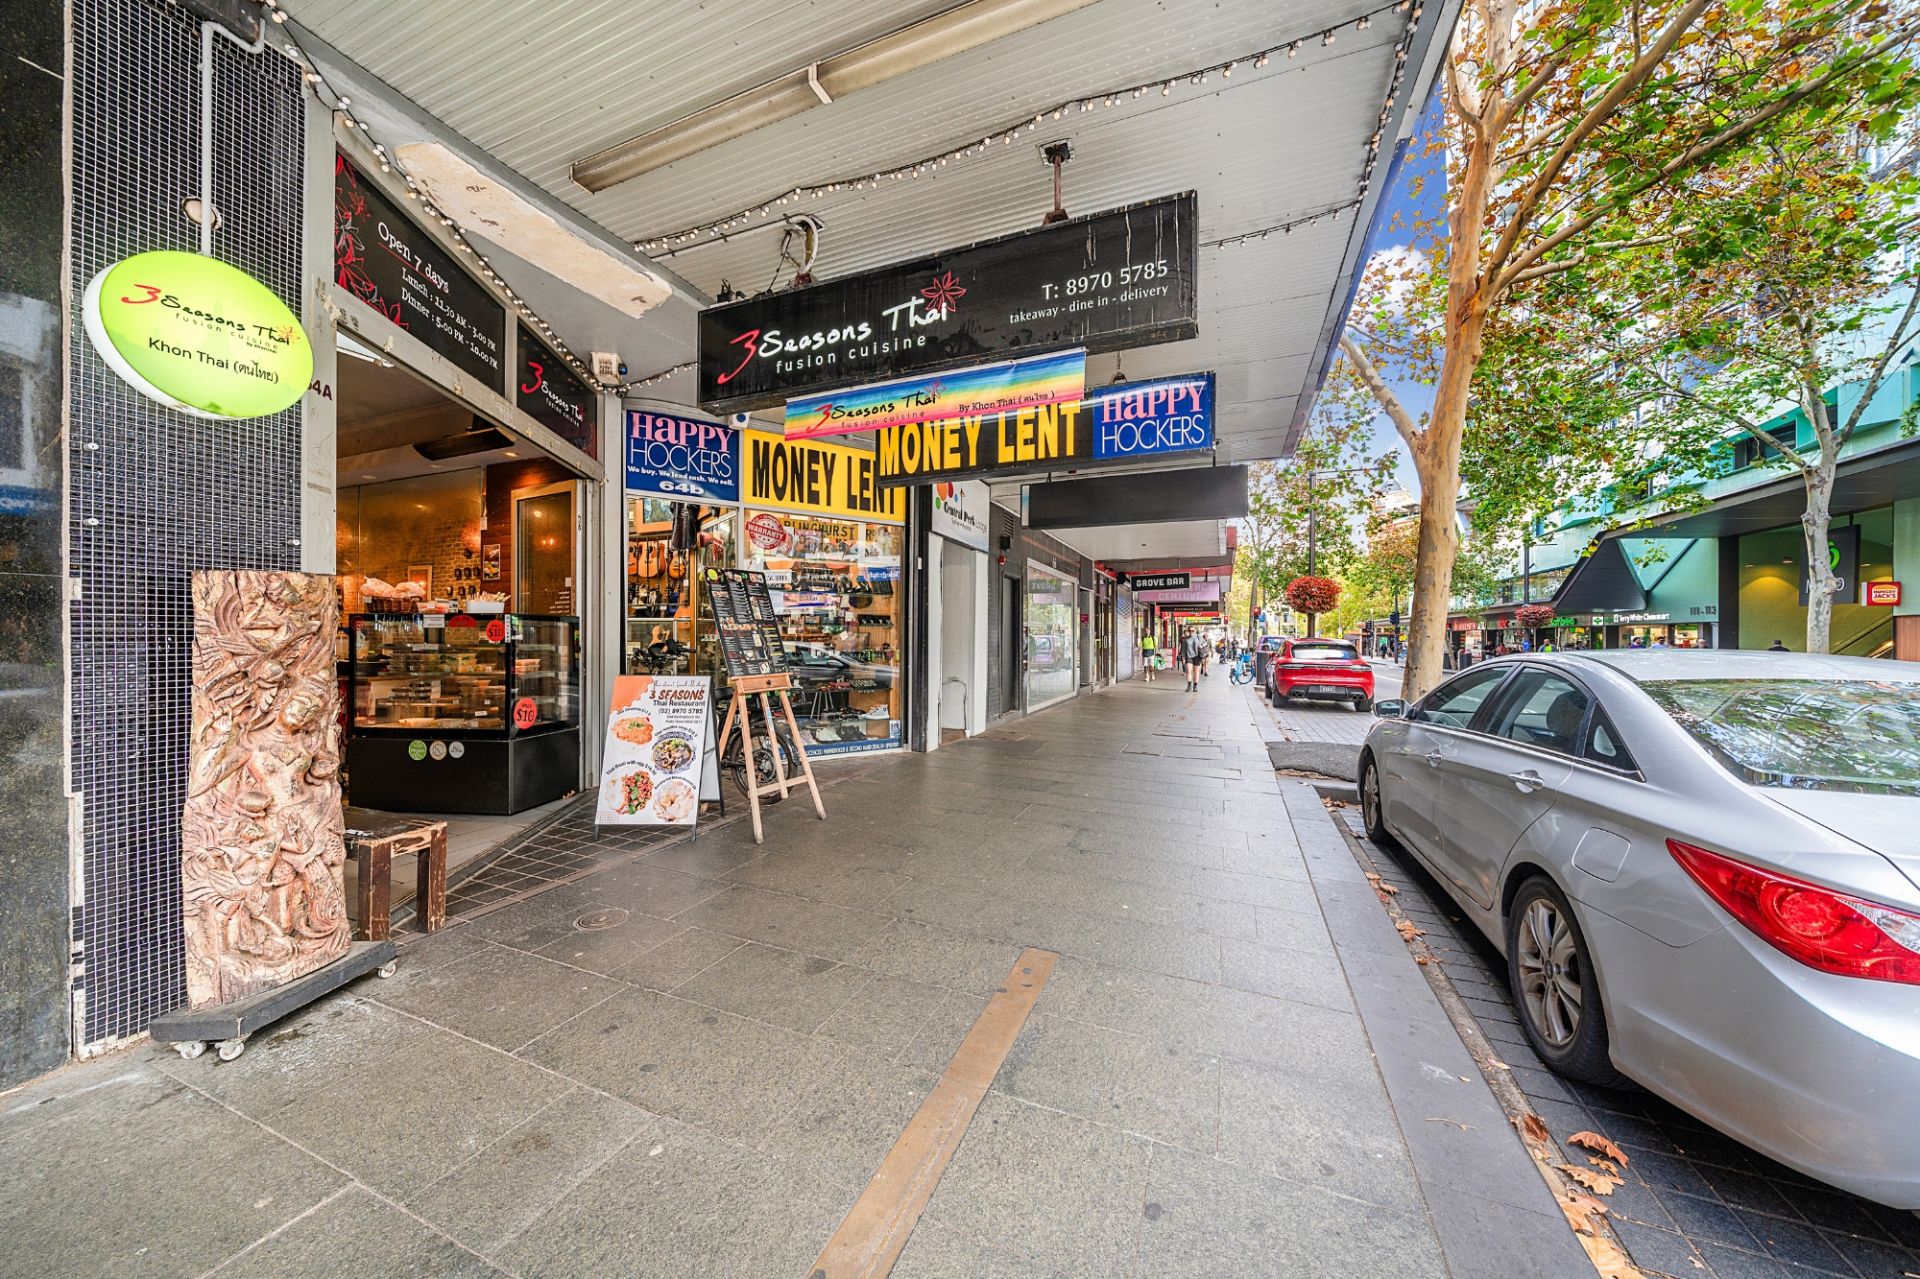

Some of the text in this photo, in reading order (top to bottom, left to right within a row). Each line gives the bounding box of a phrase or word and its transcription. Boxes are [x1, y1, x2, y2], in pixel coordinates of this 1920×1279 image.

[377, 222, 449, 293] Open 7 days
[1042, 260, 1168, 300] T: 8970 5785
[121, 284, 290, 345] 3 Seasons Thai
[401, 267, 428, 301] Lunch
[456, 311, 467, 329] AM
[487, 338, 496, 352] PM
[1010, 305, 1059, 324] takeaway
[1069, 300, 1094, 313] dine
[1098, 296, 1108, 307] in
[1120, 285, 1169, 302] delivery
[176, 312, 279, 350] fusion cuisine
[401, 287, 430, 319] Dinner
[454, 329, 465, 345] PM
[489, 355, 498, 370] PM
[717, 296, 947, 385] 3 Seasons Thai
[149, 337, 192, 360] Khon
[197, 350, 229, 370] Thai
[776, 334, 926, 374] fusion cuisine
[308, 379, 332, 401] 4A
[521, 361, 544, 394] 3
[806, 391, 936, 433] 3 Seasons Thai
[958, 403, 970, 414] By
[971, 400, 996, 412] Khon
[997, 397, 1017, 407] Thai
[879, 400, 1081, 477] MONEY LENT
[1102, 414, 1205, 454] HOCKERS
[627, 465, 640, 473] We
[641, 467, 658, 476] buy.
[671, 471, 688, 480] lend
[630, 441, 732, 478] HOCKERS
[752, 439, 836, 507] MONEY
[659, 480, 704, 495] 64b
[747, 523, 784, 540] WARRANTY
[1136, 577, 1185, 588] GROVE BAR
[649, 689, 705, 701] 3 SEASONS
[515, 708, 535, 723] $10
